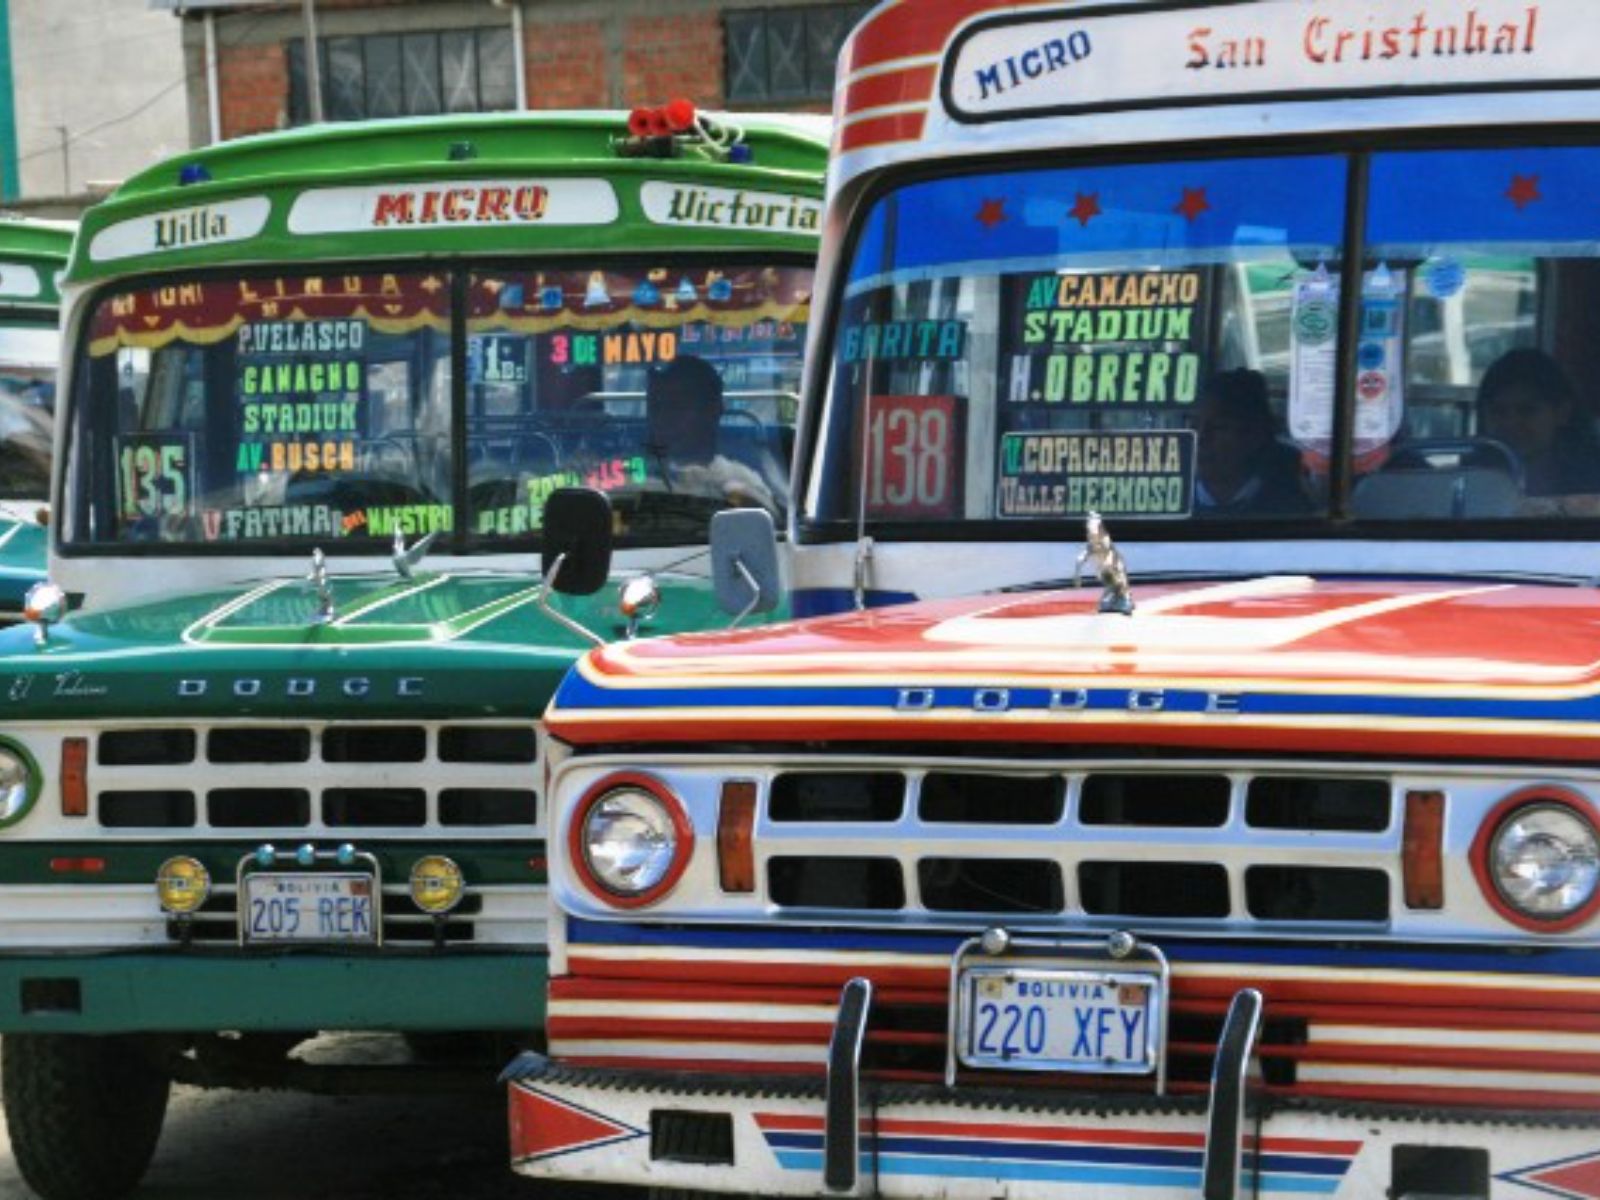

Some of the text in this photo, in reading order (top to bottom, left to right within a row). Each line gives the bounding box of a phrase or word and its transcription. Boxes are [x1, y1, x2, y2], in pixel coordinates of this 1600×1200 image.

[974, 29, 1093, 100] MICRO
[1185, 28, 1266, 69] San
[372, 185, 548, 226] MICRO
[667, 188, 817, 229] Victoria
[154, 208, 227, 248] Villa
[1058, 273, 1198, 308] CAMACHO
[843, 320, 961, 362] GARITA
[1024, 307, 1193, 343] STADIUM
[551, 332, 676, 364] 3 DE MAYO
[244, 403, 358, 433] STADIUM
[870, 408, 948, 507] 138
[119, 445, 186, 515] 135
[1067, 475, 1184, 513] HERMOSO
[479, 504, 545, 536] PERE
[178, 676, 425, 697] DODGE
[893, 686, 1242, 714] DODGE
[277, 881, 340, 893] BOLIVIA
[253, 896, 370, 933] 205 REK
[1017, 981, 1105, 1000] BOLIVIA
[978, 1002, 1143, 1060] 220 XFY
